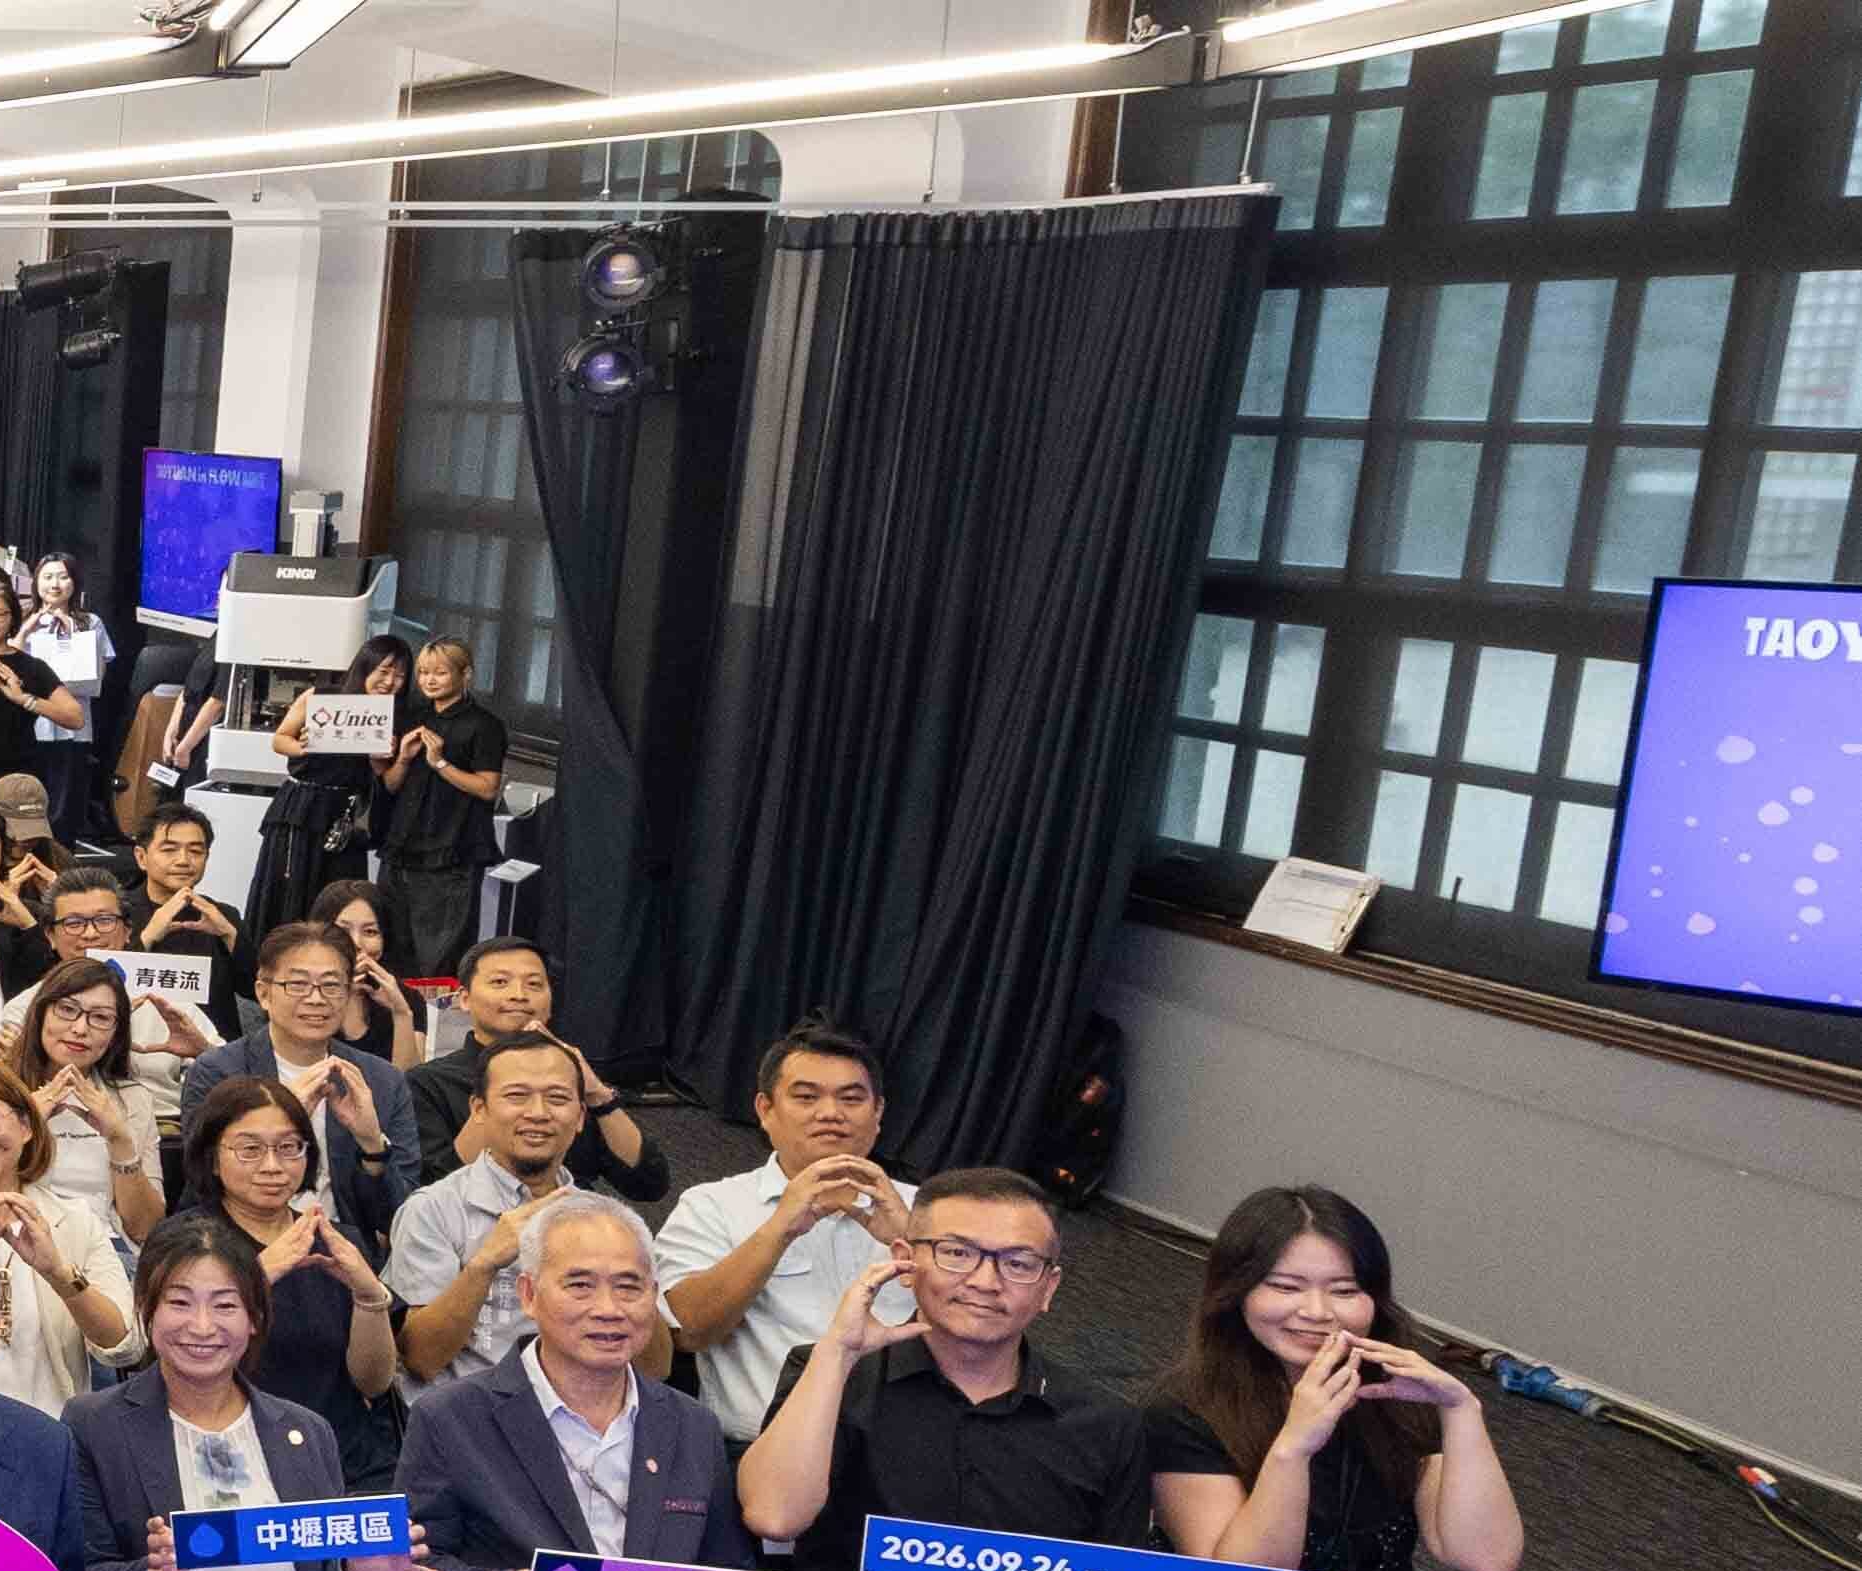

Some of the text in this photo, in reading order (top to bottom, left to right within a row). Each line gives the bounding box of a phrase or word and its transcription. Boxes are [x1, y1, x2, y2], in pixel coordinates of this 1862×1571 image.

[332, 709, 388, 728] Unice
[135, 968, 200, 992] 青春流
[255, 1511, 393, 1551] 中壢展區
